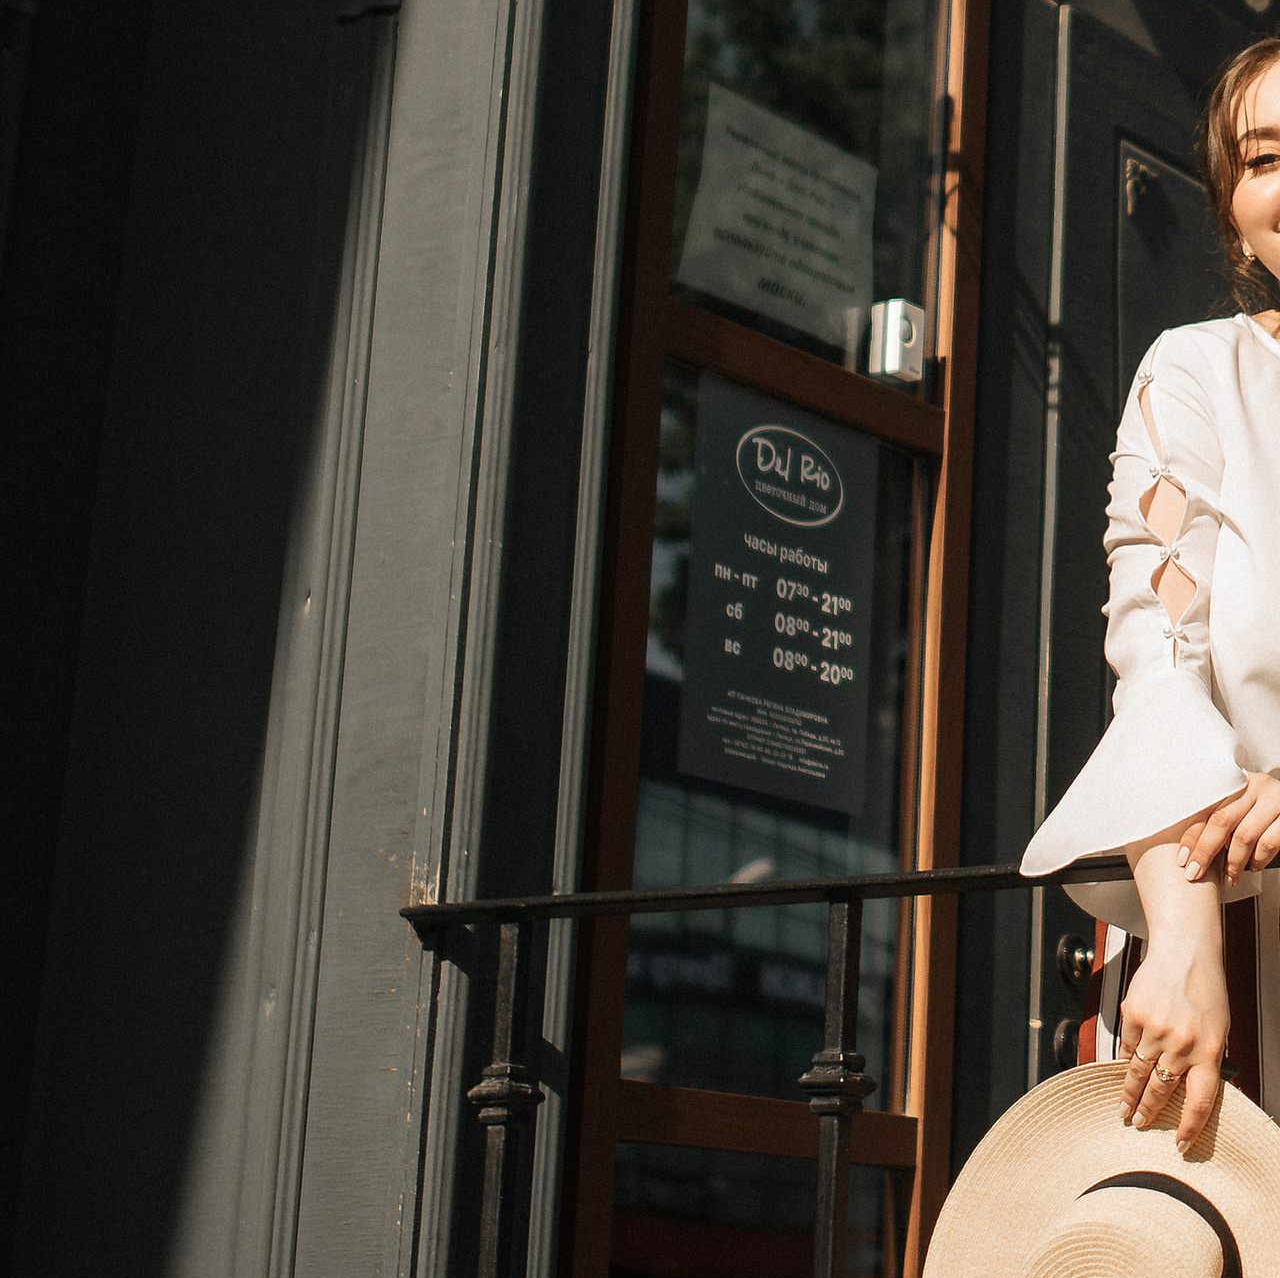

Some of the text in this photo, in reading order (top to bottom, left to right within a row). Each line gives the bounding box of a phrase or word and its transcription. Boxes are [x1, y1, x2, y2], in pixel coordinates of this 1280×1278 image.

[752, 437, 831, 491] Del Rio
[755, 480, 827, 515] цветочный дом
[744, 533, 828, 574] часы работы
[725, 602, 743, 620] сб
[724, 638, 741, 655] вс
